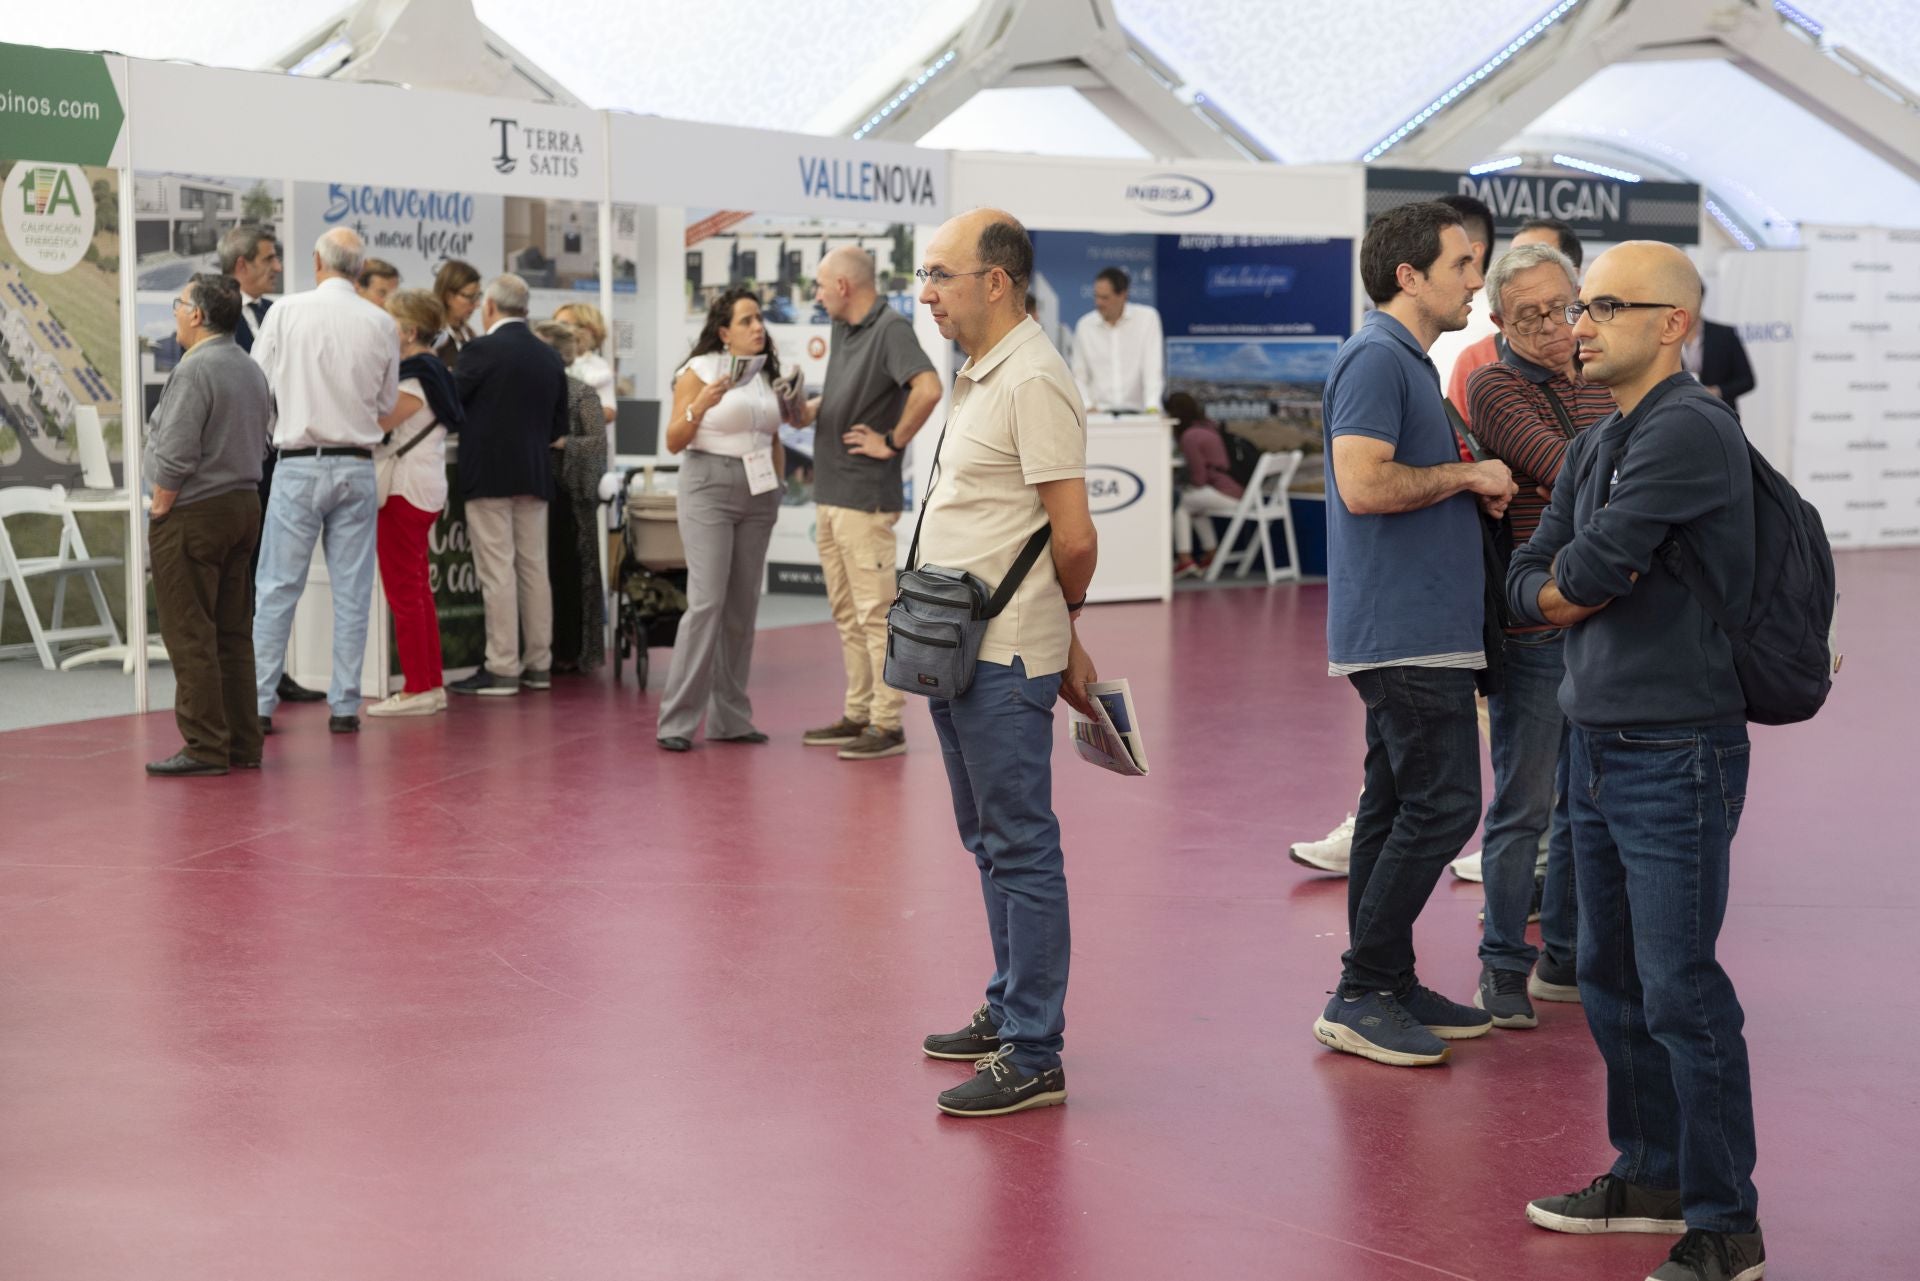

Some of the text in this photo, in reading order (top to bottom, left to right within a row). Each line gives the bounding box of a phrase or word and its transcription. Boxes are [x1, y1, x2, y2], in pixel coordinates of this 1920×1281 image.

[523, 127, 583, 154] TERRA
[529, 153, 579, 177] SATIS
[799, 156, 935, 206] VALLENOVA
[1126, 184, 1193, 201] INBISA
